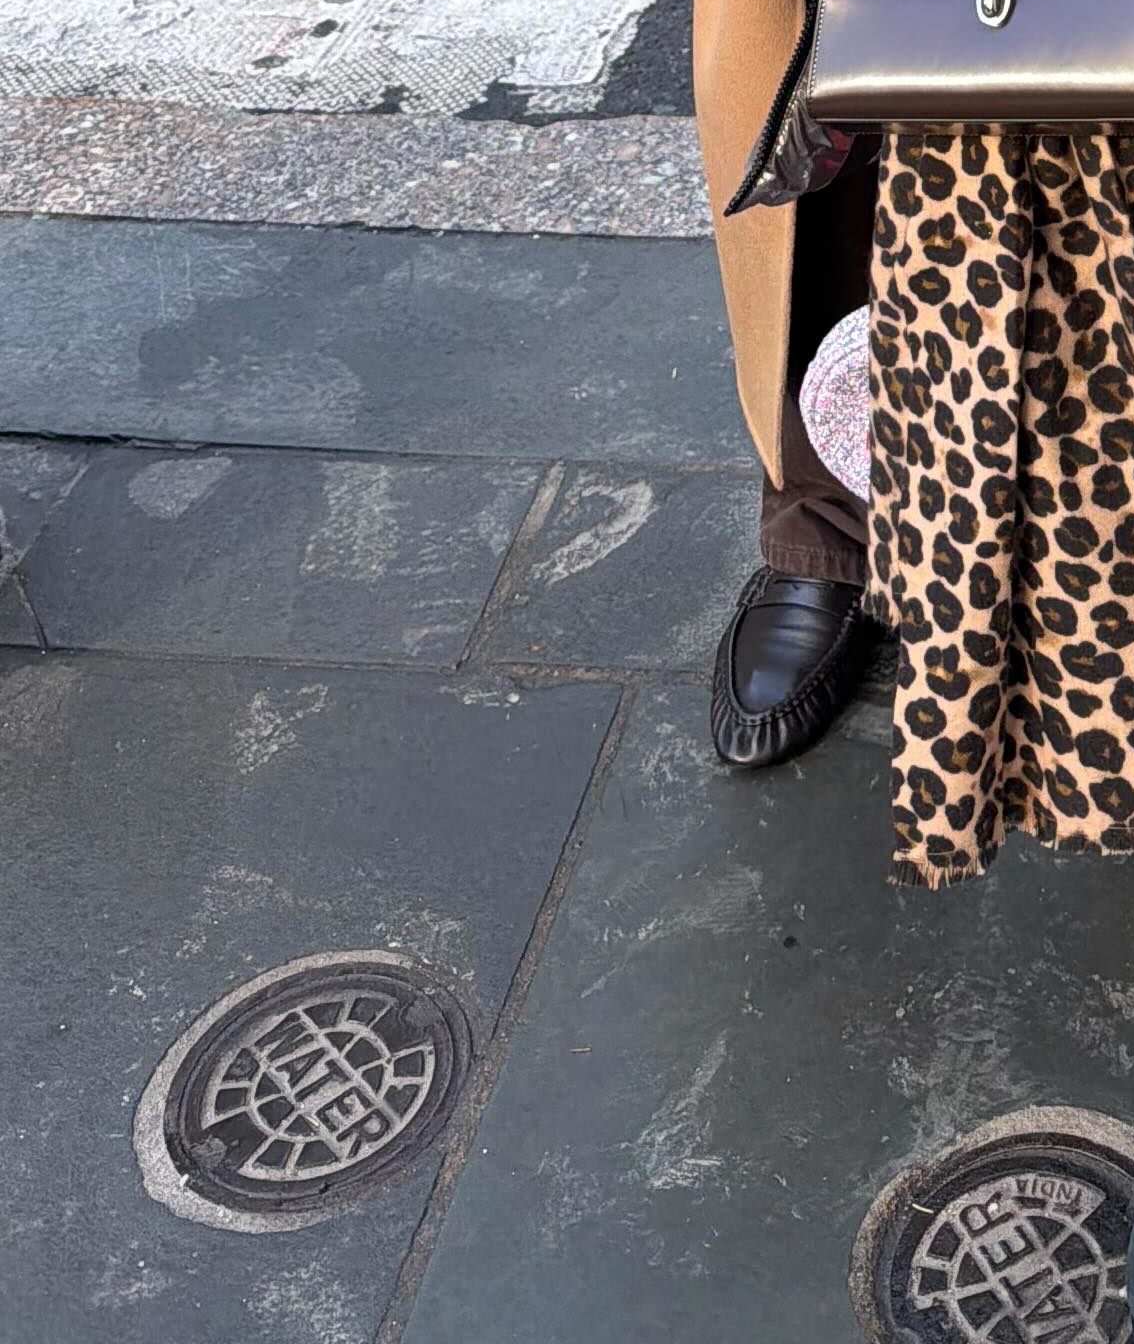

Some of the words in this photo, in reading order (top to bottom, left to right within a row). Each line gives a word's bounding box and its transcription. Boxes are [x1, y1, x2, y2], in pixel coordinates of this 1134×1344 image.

[252, 1012, 390, 1158] WATER
[1015, 1177, 1082, 1207] INDIA
[959, 1192, 1086, 1344] ATER
